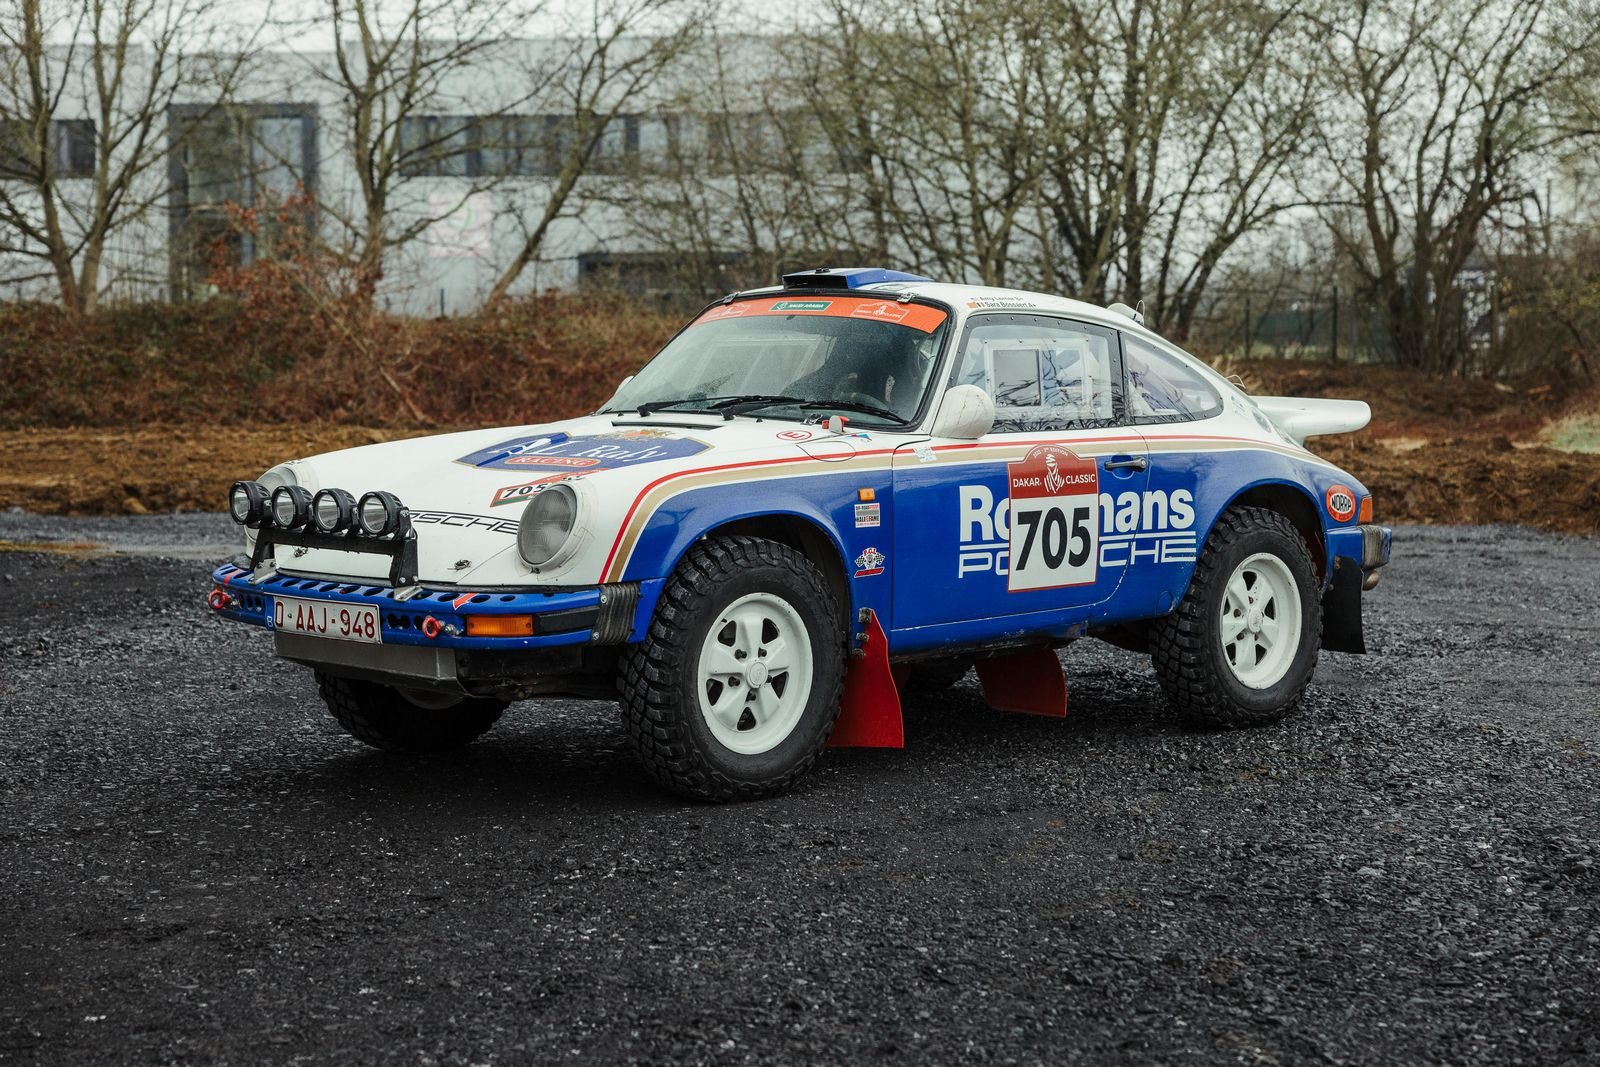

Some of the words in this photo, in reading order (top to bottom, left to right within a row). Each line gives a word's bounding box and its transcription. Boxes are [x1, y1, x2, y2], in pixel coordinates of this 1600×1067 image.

[514, 457, 591, 466] RACING
[1013, 477, 1041, 488] DAKAR
[1065, 473, 1096, 484] CLASSIC
[1331, 494, 1352, 512] NORRA
[1015, 506, 1092, 571] 705
[266, 615, 274, 628] B
